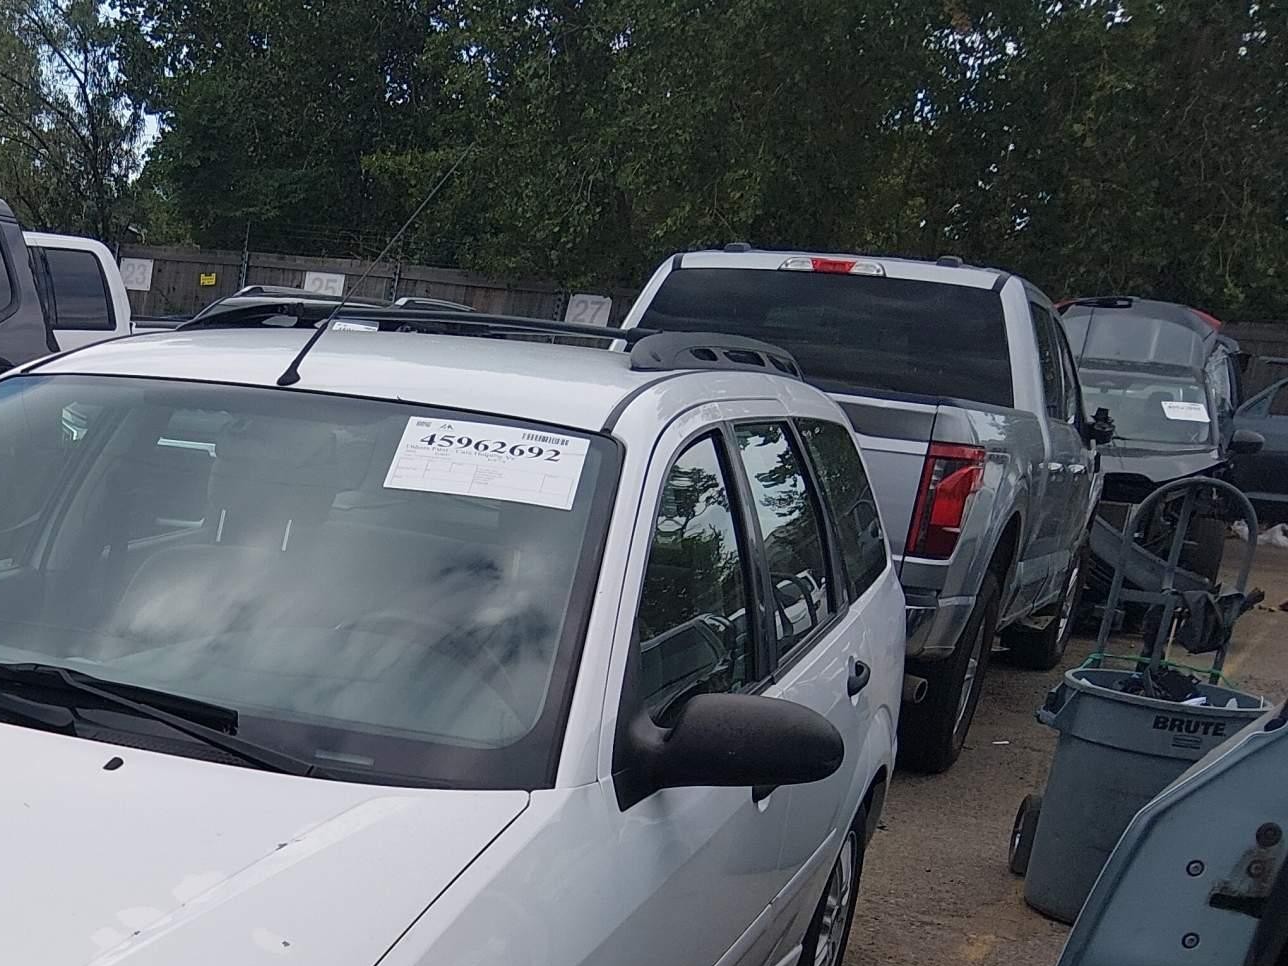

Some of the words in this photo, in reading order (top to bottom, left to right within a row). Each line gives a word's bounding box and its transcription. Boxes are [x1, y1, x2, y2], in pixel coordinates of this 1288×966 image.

[123, 263, 147, 285] 23
[312, 277, 337, 293] 25
[573, 300, 606, 324] 27
[420, 433, 561, 462] 45962692
[1153, 715, 1226, 736] BRUTE
